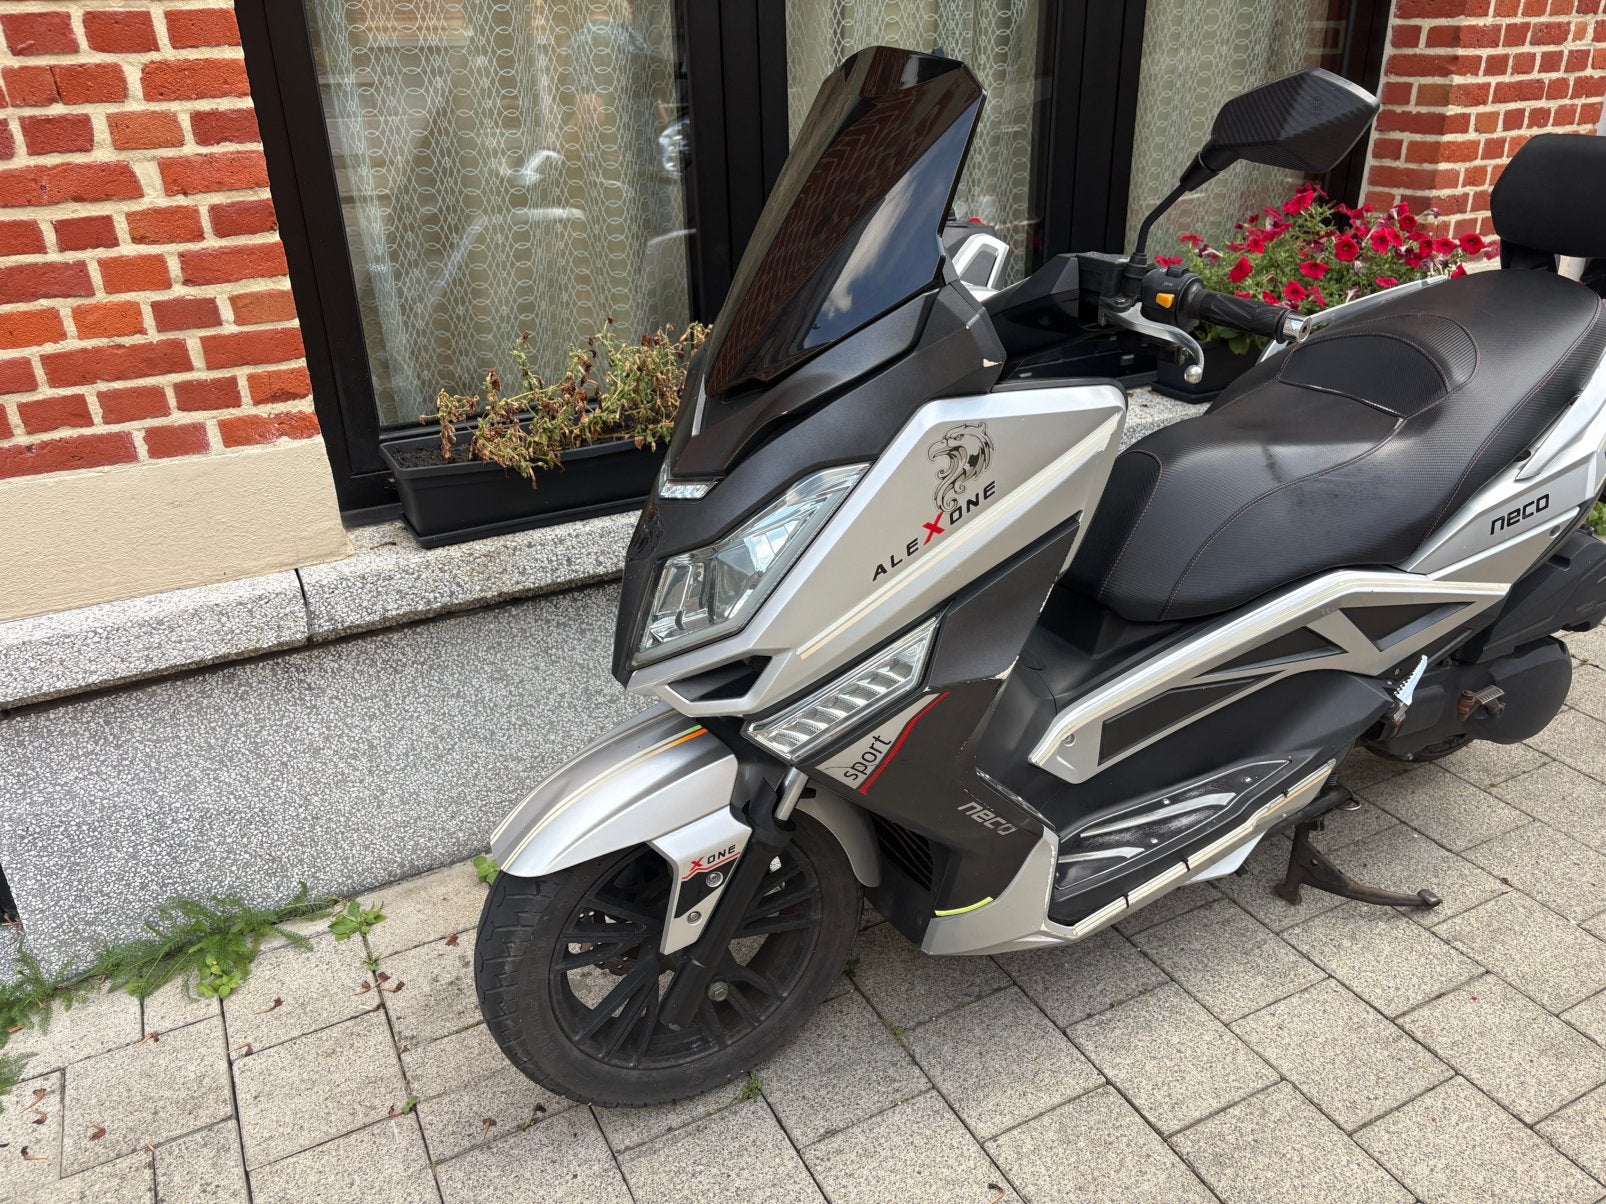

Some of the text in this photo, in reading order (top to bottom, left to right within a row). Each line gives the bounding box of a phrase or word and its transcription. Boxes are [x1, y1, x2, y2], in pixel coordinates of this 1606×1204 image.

[1490, 493, 1550, 536] neco
[843, 735, 892, 781] sport
[957, 801, 1018, 836] neco
